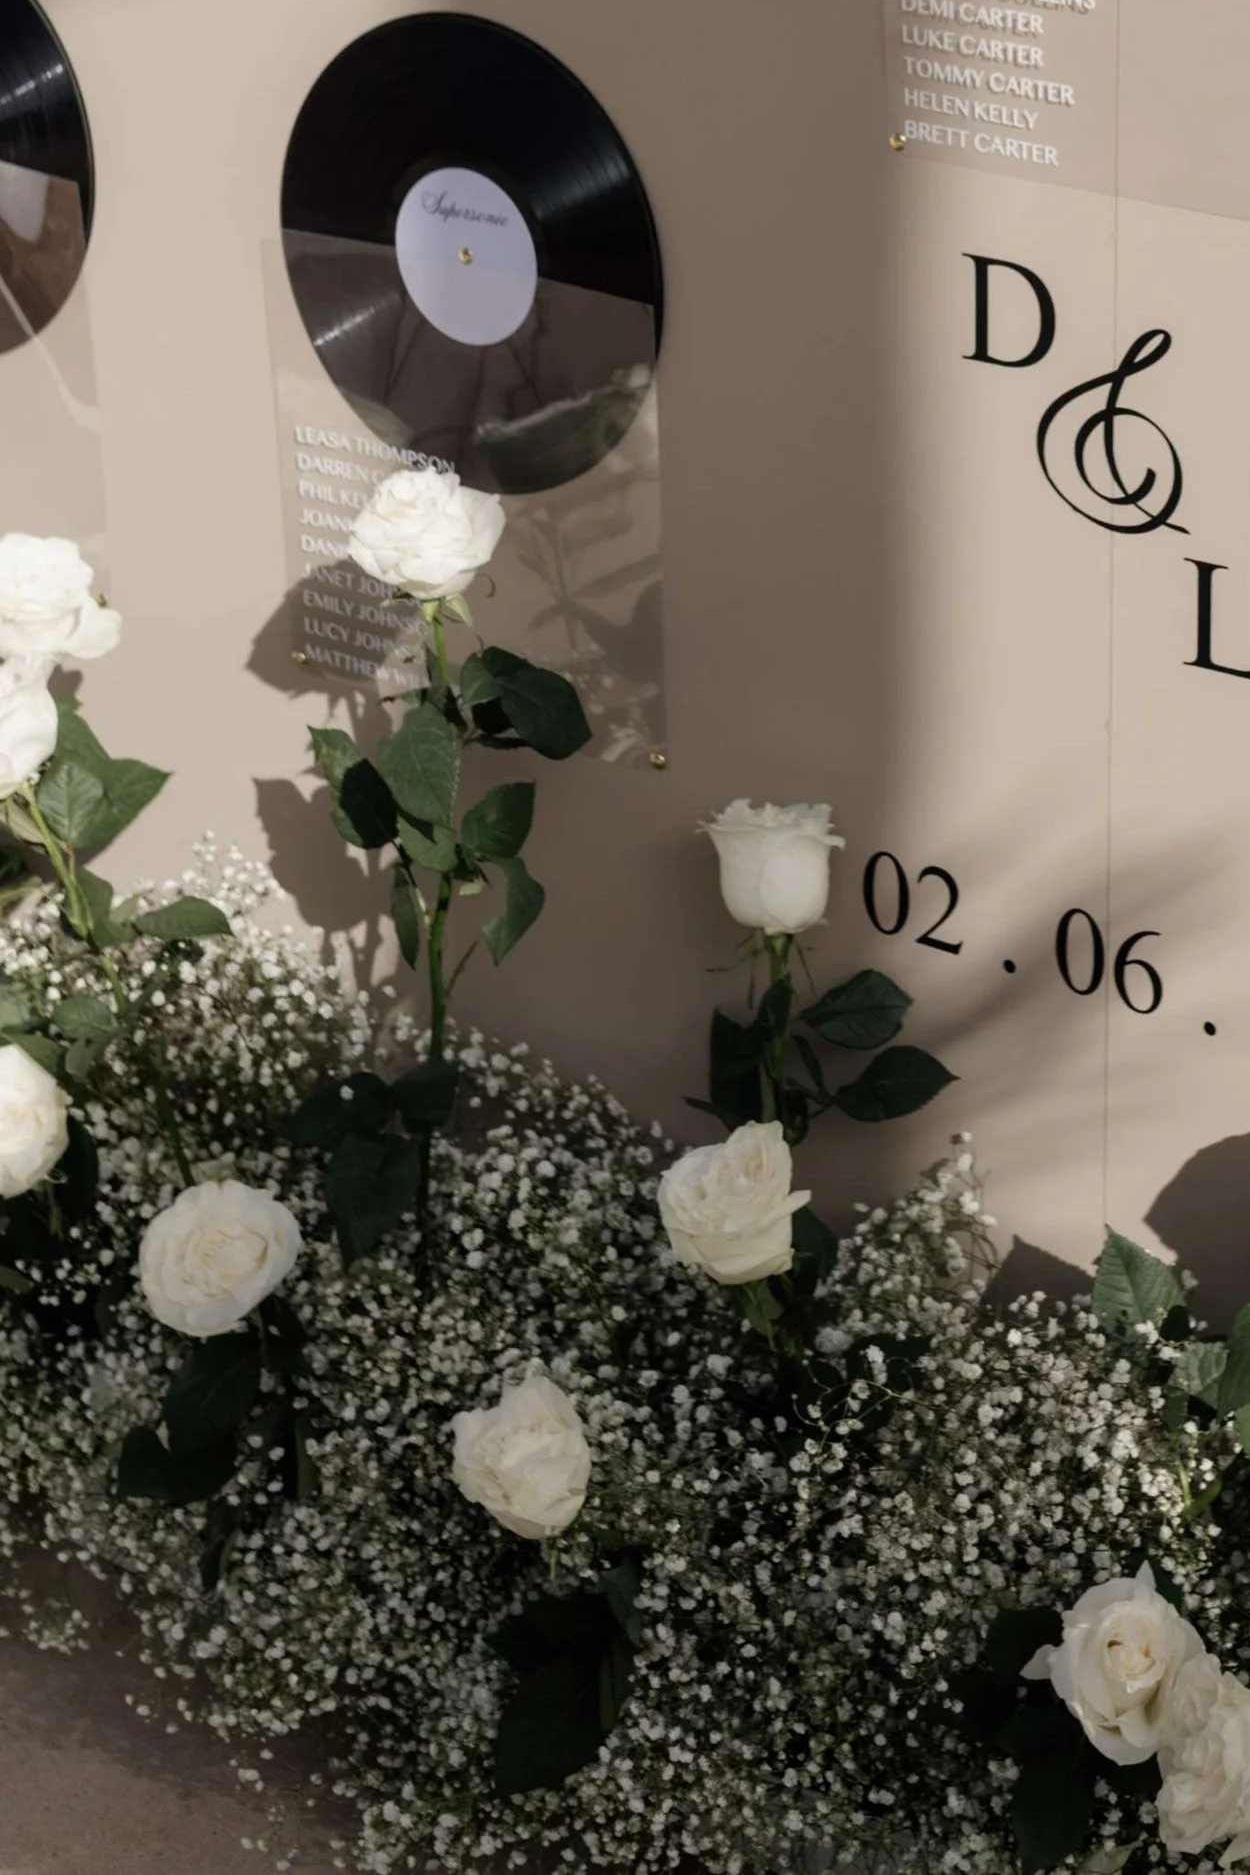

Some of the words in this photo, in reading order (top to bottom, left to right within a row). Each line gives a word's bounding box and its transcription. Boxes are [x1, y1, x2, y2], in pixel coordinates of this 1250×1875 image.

[960, 4, 1044, 34] CARTER
[902, 25, 955, 51] LUKE
[960, 36, 1044, 67] CARTER
[904, 56, 984, 88] TOMMY
[989, 73, 1075, 105] CARTER
[904, 88, 969, 118] HELEN
[974, 103, 1039, 130] KELLY
[905, 120, 969, 148] BRETT
[974, 133, 1058, 166] CARTER
[421, 191, 509, 227] Supersonic
[961, 252, 1056, 368] D
[1036, 329, 1191, 535] &
[295, 426, 350, 453] LEASA
[355, 437, 455, 474] THOMPSON
[297, 453, 371, 483] DARREN
[299, 481, 339, 504] PHIL
[303, 563, 354, 589] JANET
[303, 590, 353, 615] EMILY
[304, 618, 349, 643] LUCY
[305, 645, 393, 680] MATTHEW
